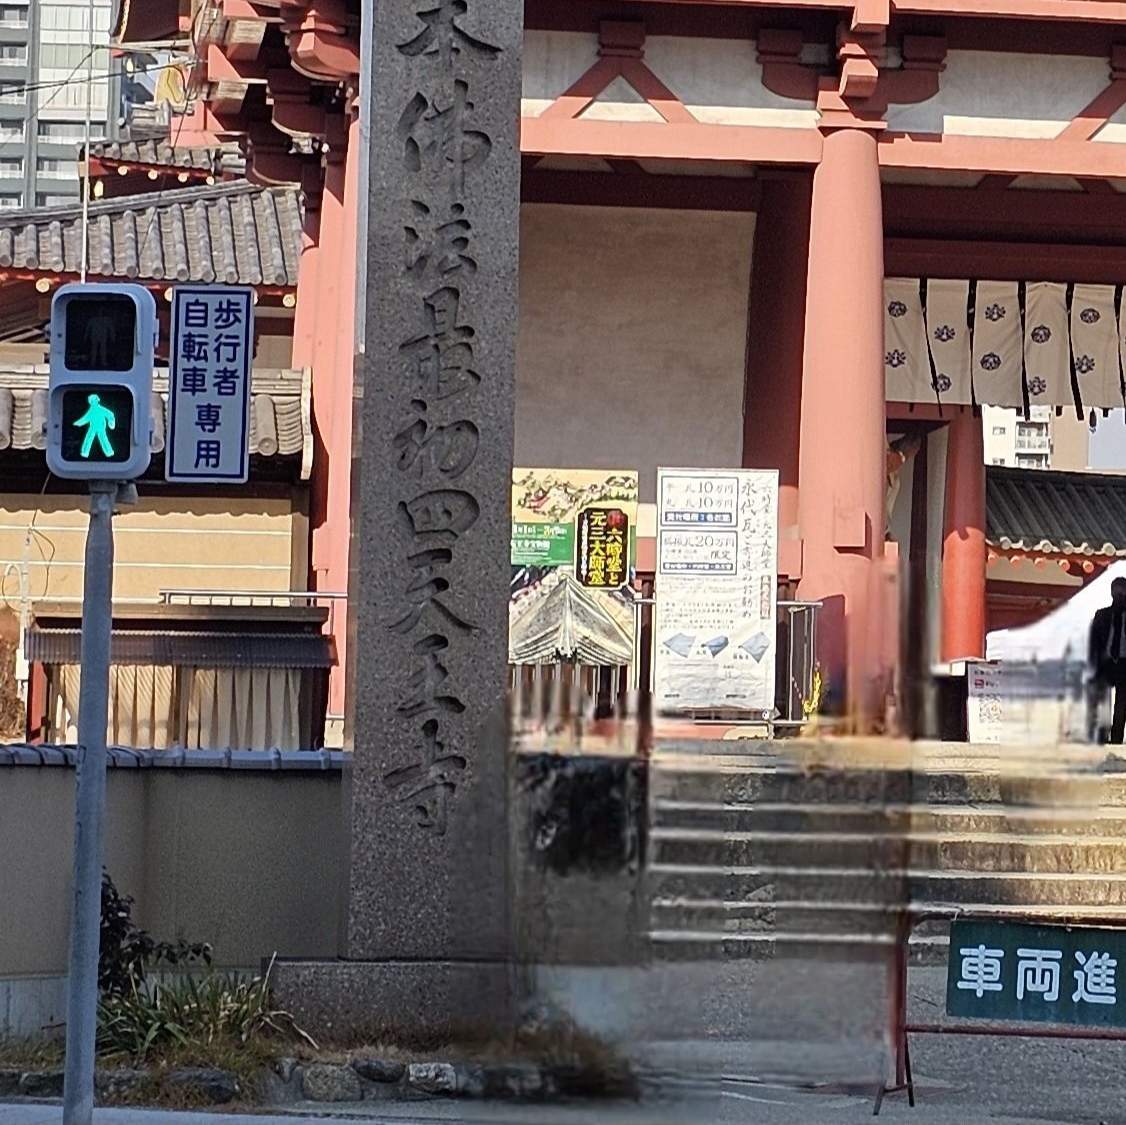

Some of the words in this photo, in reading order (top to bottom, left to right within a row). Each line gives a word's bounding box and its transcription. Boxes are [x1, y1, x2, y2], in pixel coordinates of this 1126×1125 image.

[181, 298, 210, 397] 自転車
[212, 298, 242, 397] 歩行者
[194, 402, 222, 470] 専用
